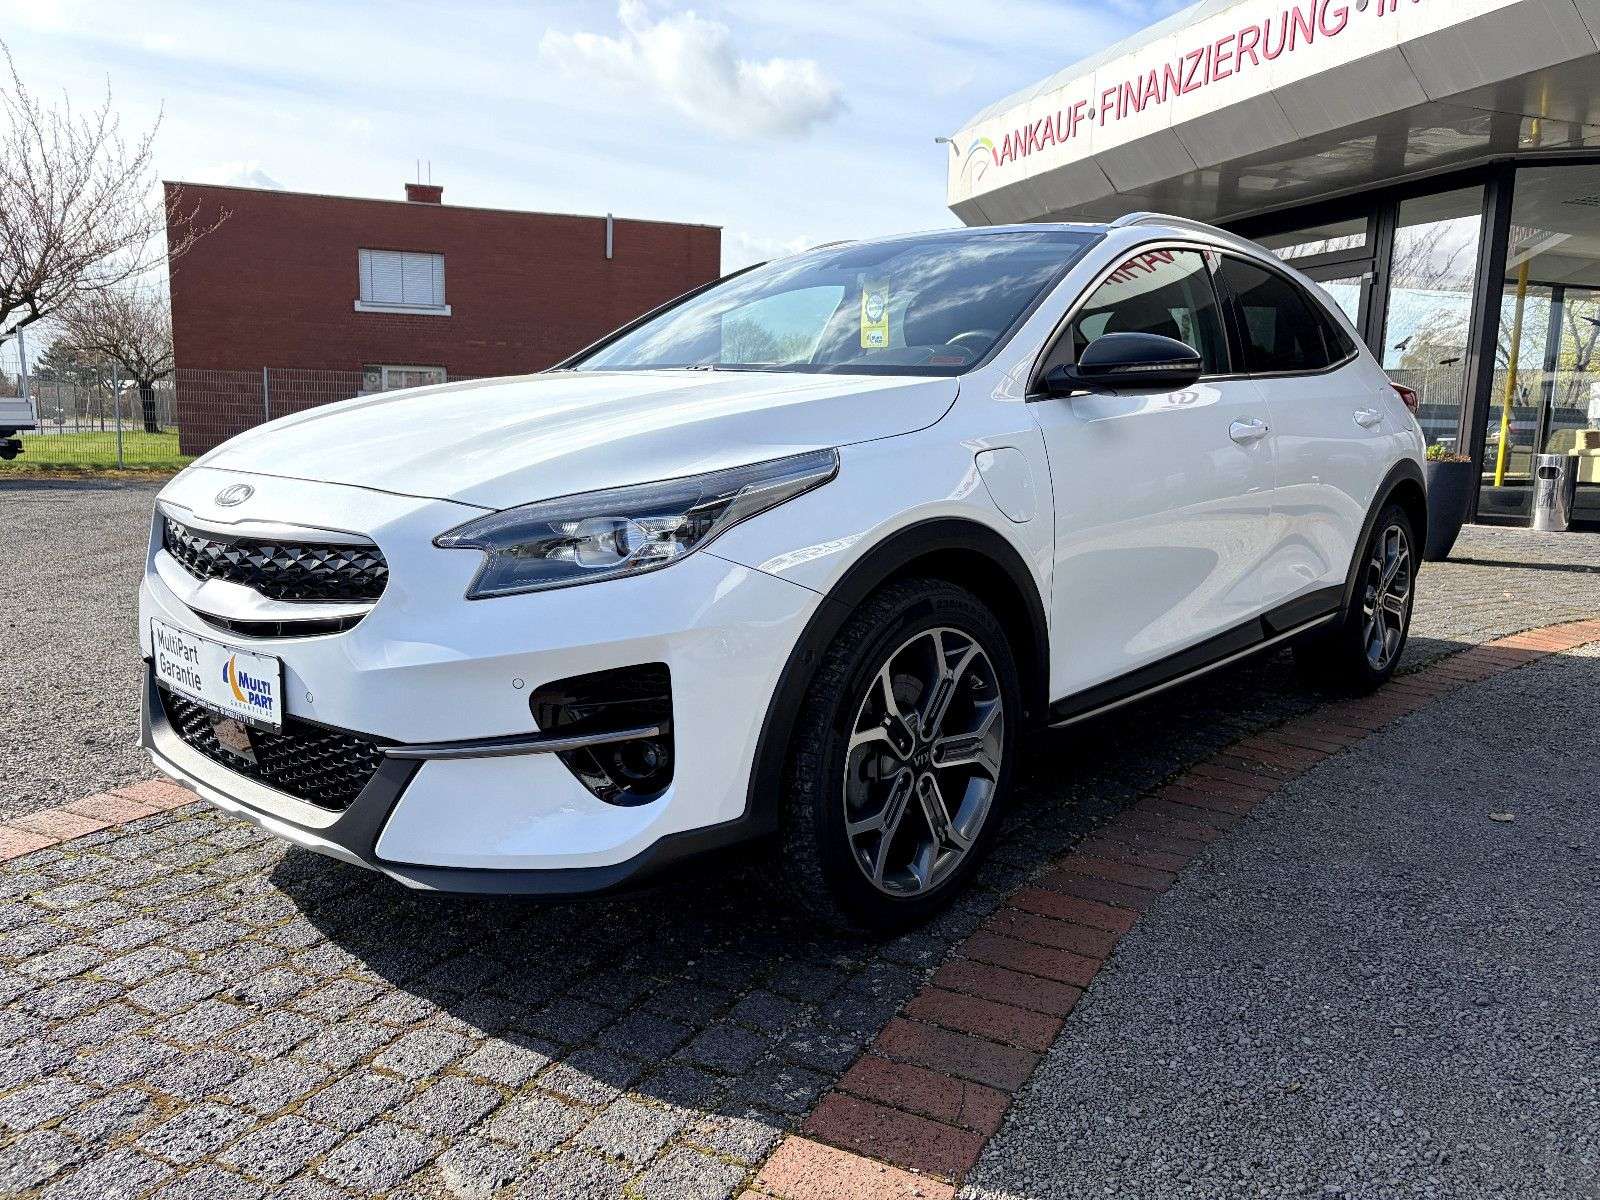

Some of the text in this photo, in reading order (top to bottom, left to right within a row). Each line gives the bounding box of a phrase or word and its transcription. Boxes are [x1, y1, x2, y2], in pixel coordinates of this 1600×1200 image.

[1000, 0, 1349, 167] ANKAUF FINANZIERUNG
[157, 628, 199, 665] MultiPart
[159, 652, 202, 691] Garantie
[238, 670, 271, 695] MULTI
[248, 691, 273, 711] PART
